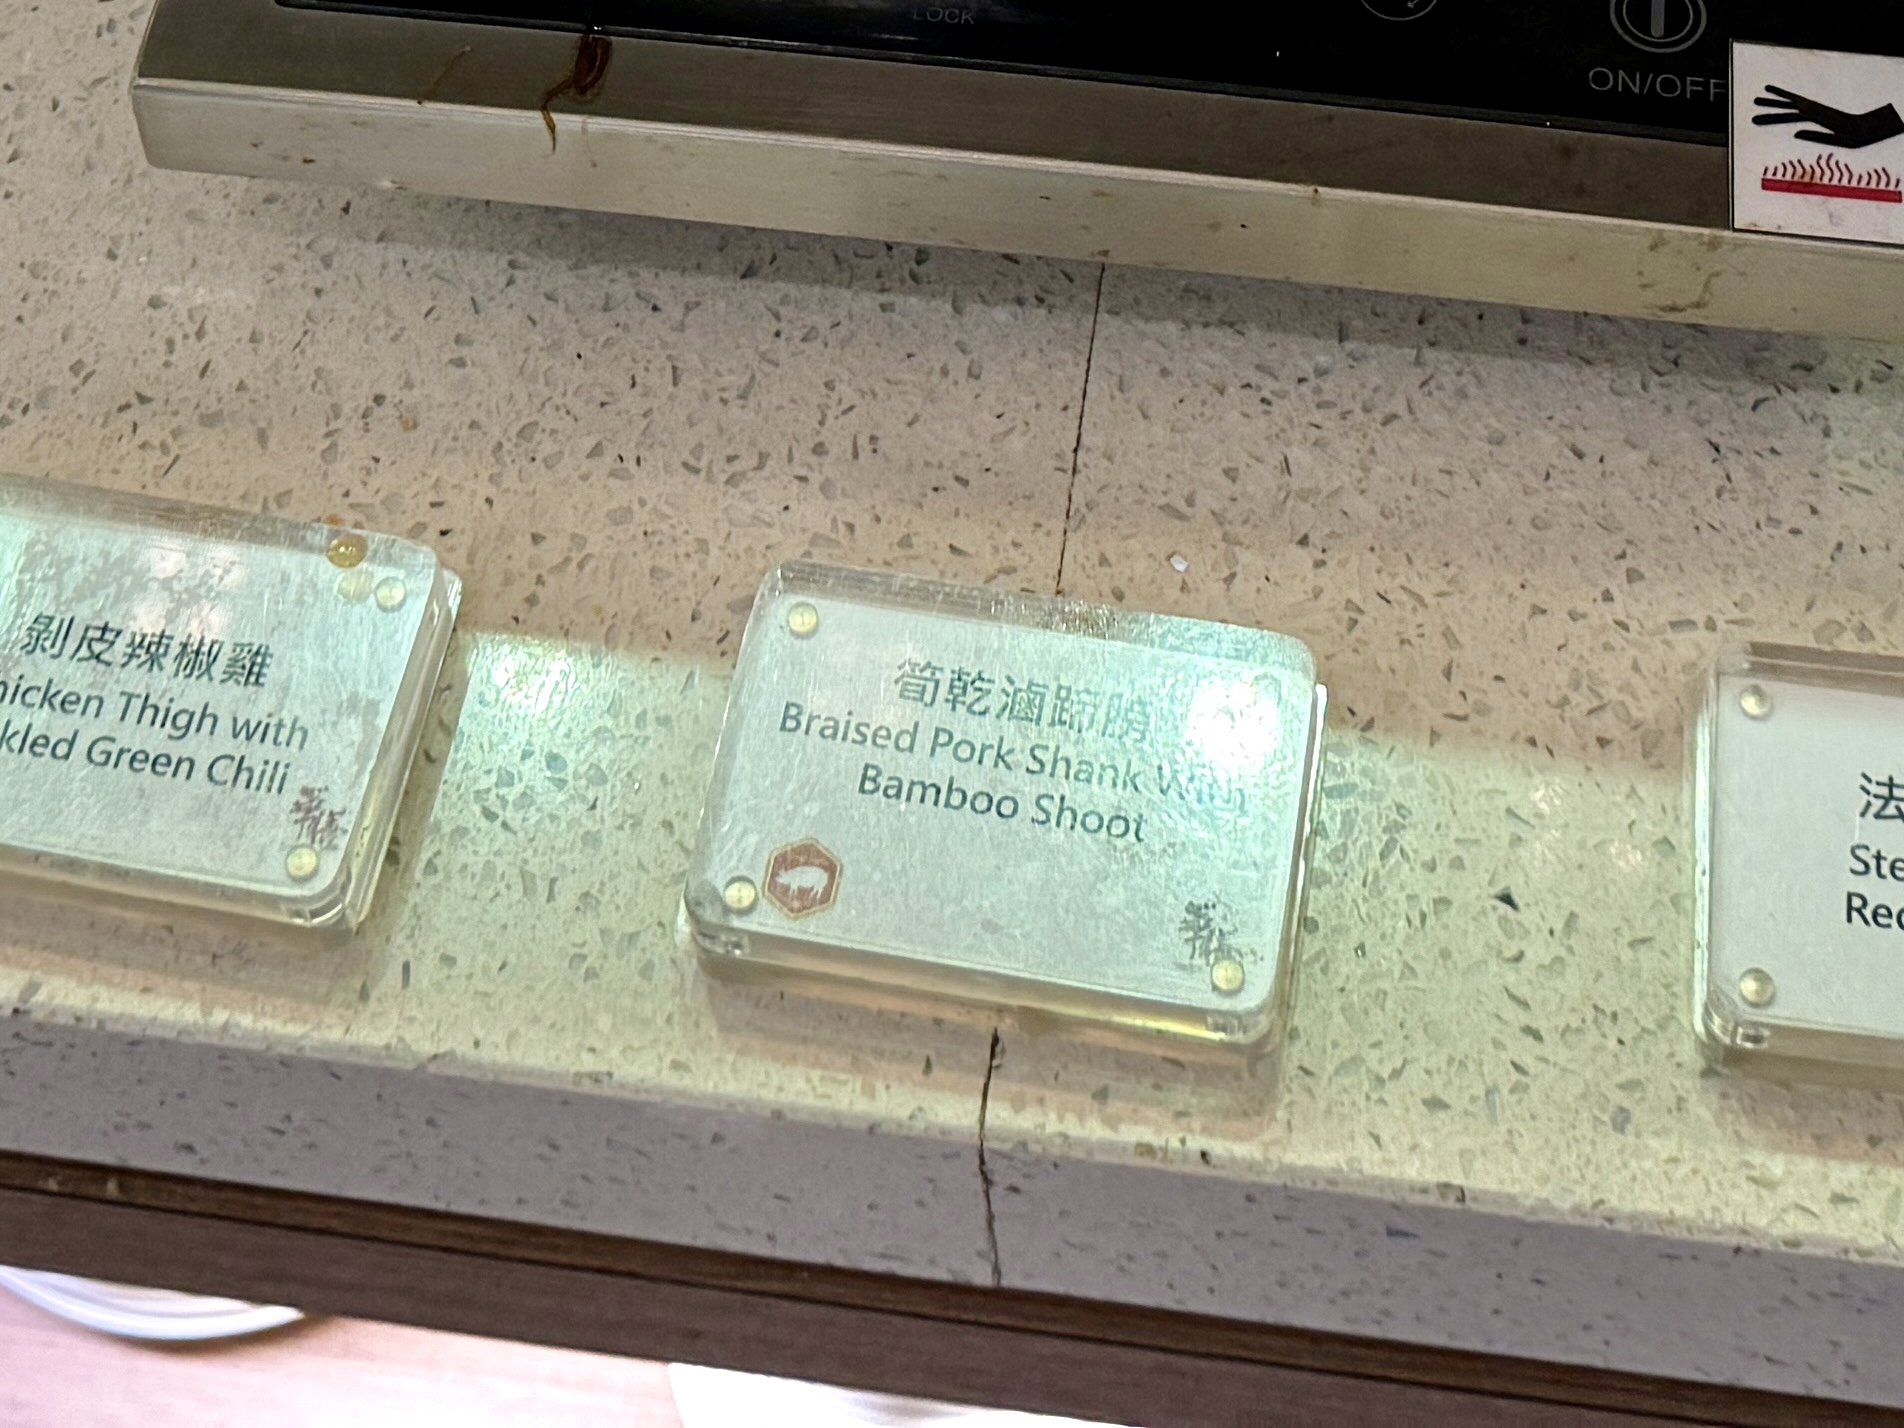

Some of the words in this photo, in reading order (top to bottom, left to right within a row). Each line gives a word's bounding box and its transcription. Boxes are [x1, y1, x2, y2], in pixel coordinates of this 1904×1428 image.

[912, 7, 975, 25] LOCK
[1588, 66, 1729, 103] ON/OFF
[118, 691, 219, 741] Thigh
[231, 711, 310, 751] with
[778, 700, 920, 755] Braised
[928, 725, 1016, 772] Pork
[1024, 743, 1143, 793] Shank
[86, 735, 196, 782] Green
[206, 753, 292, 795] Chili
[857, 762, 1020, 820] Bamboo
[1030, 793, 1147, 843] Shoot
